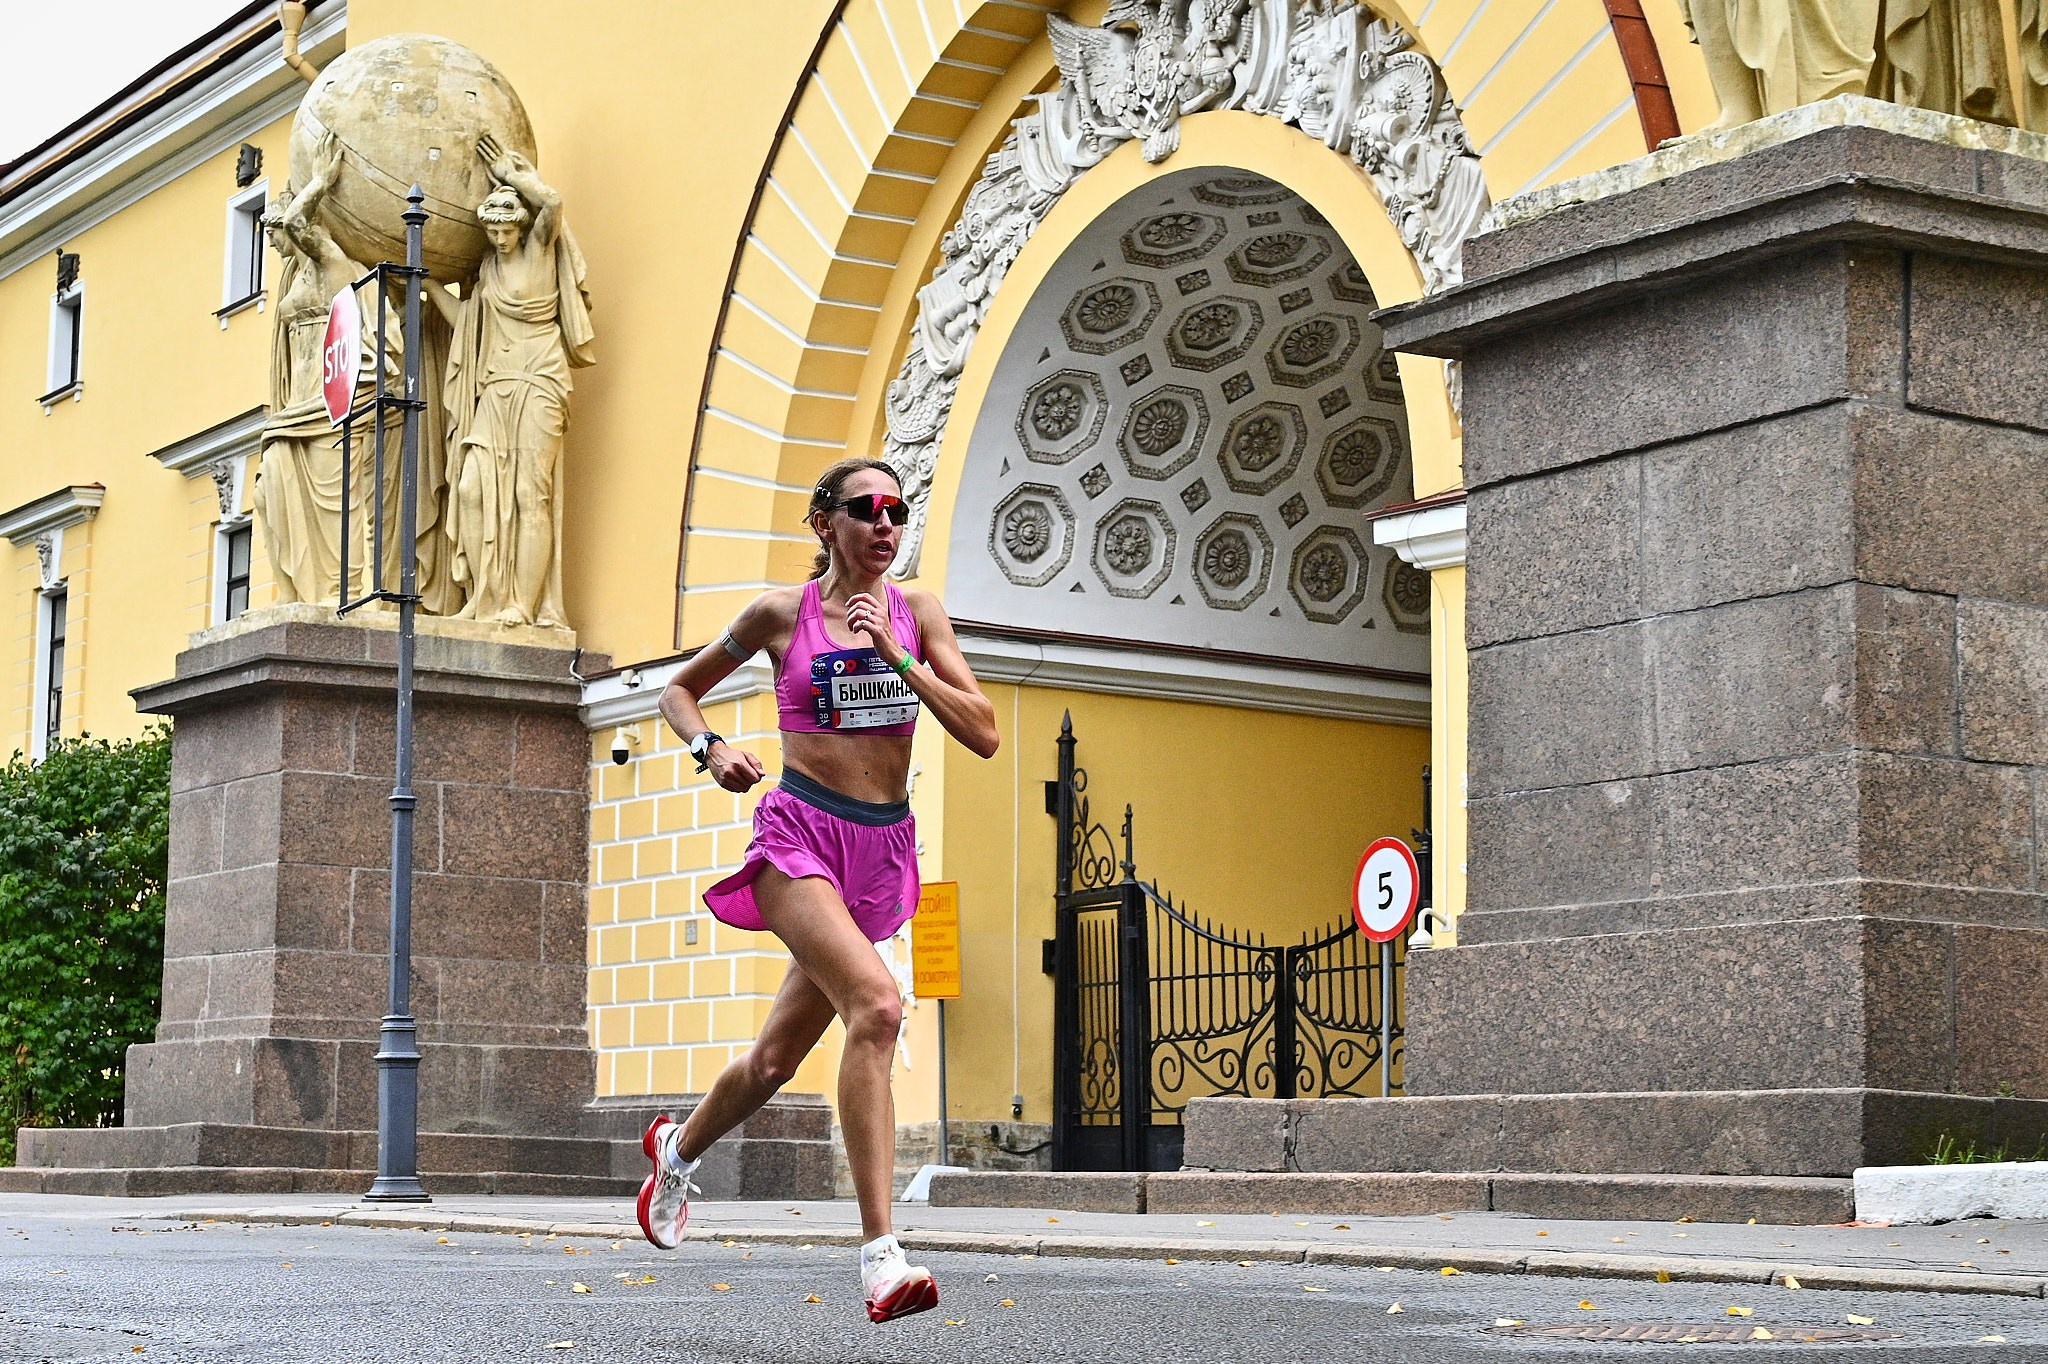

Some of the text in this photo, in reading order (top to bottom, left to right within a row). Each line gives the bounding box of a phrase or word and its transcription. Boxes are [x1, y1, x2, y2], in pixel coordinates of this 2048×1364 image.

[324, 331, 353, 384] STO
[833, 660, 857, 674] 99
[838, 680, 913, 701] БЫШКИНА
[1378, 871, 1393, 910] 5
